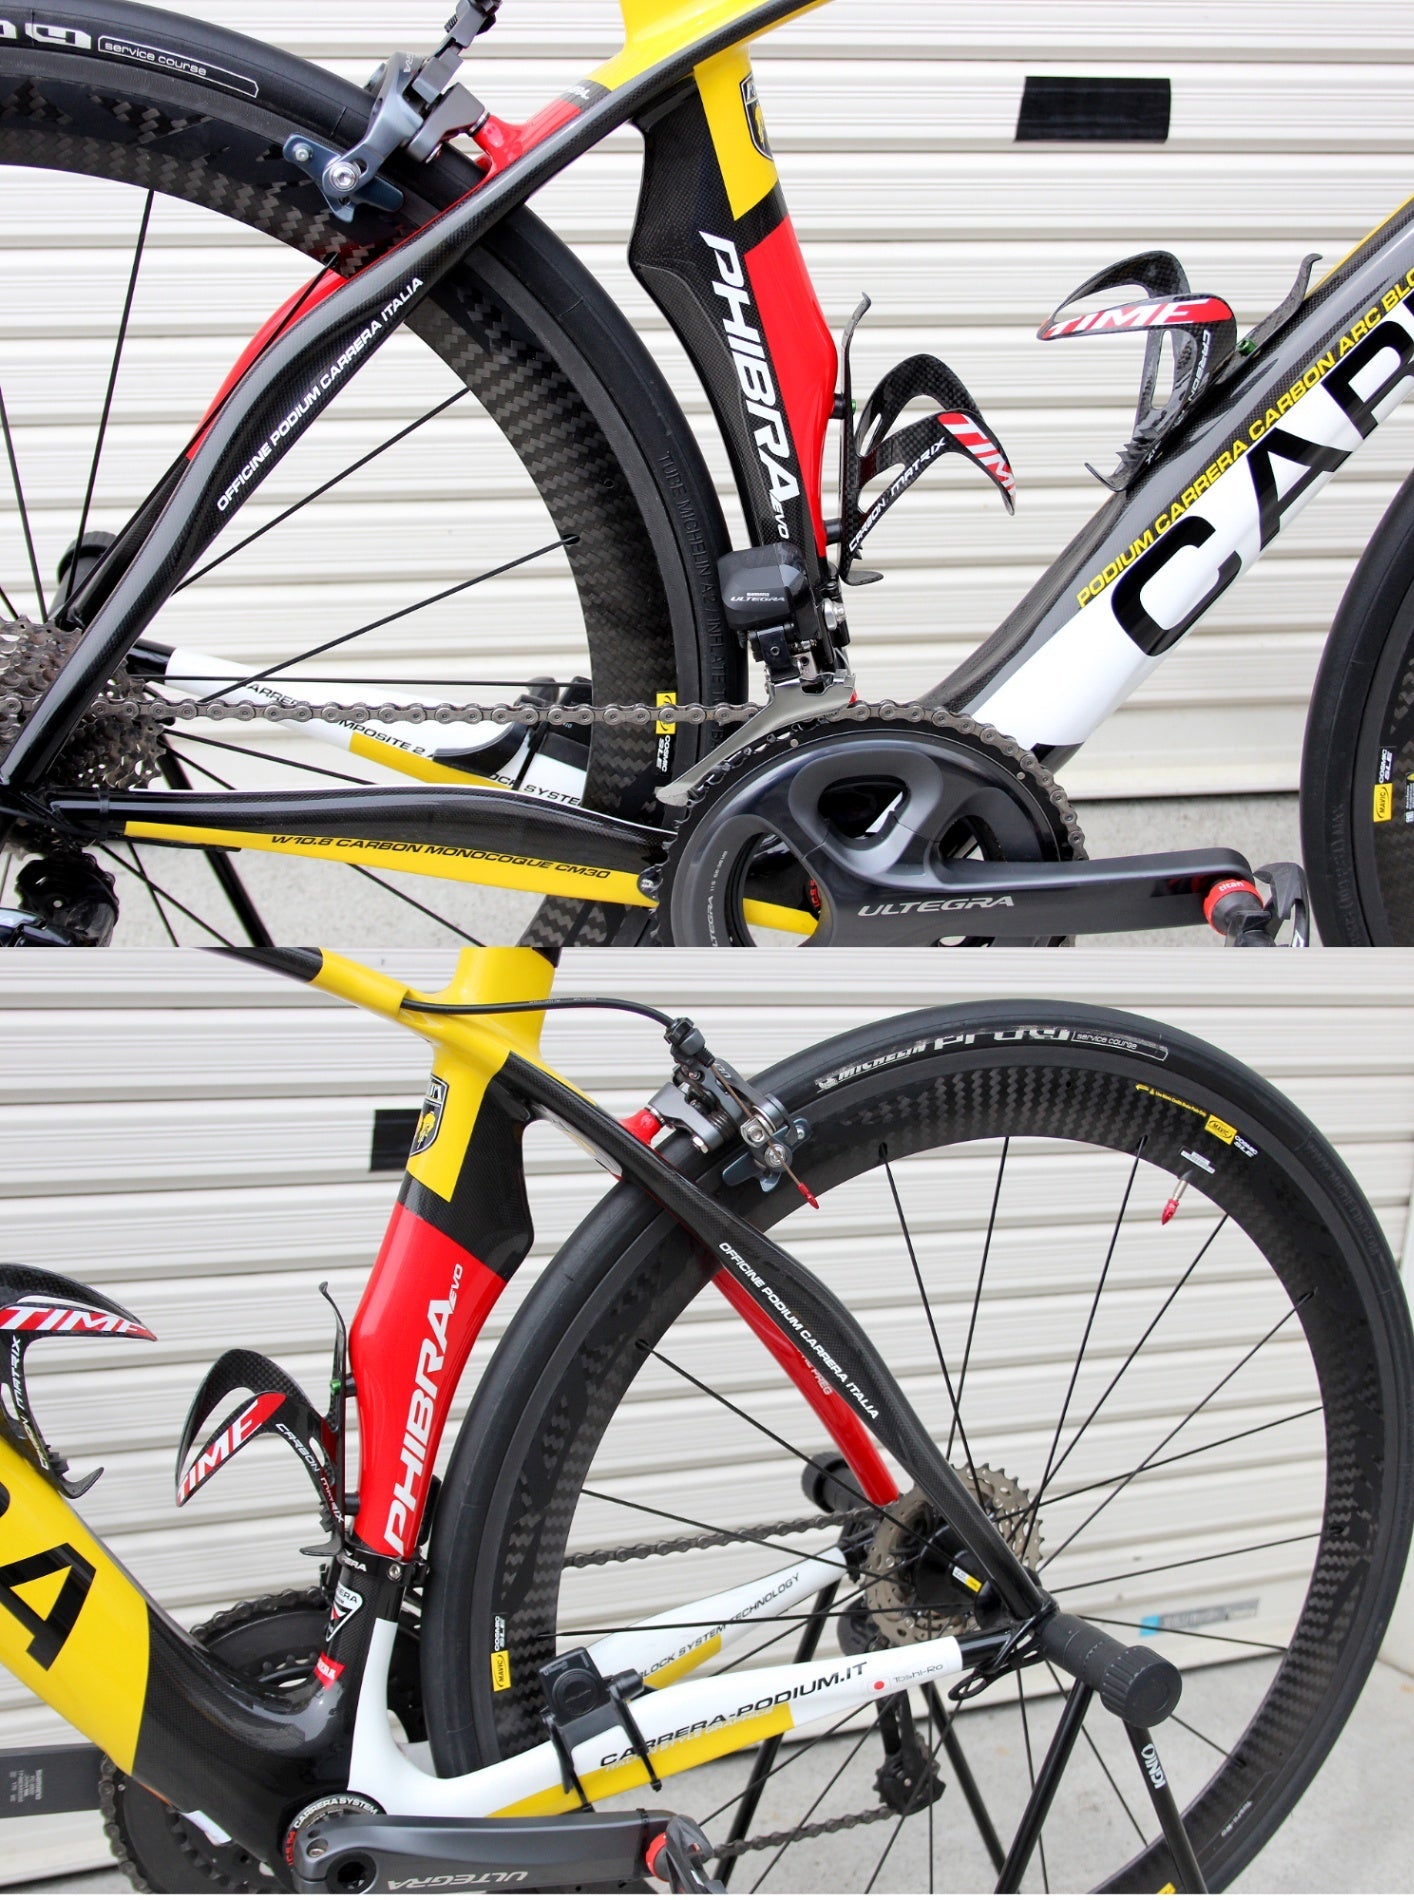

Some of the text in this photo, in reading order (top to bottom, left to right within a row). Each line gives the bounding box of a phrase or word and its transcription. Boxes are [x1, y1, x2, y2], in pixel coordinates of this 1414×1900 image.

[104, 41, 155, 62] service
[158, 54, 207, 77] course
[1048, 297, 1212, 337] TIME
[217, 277, 424, 511] OFFICINE PODIUM CARRERA ITALIA
[698, 230, 800, 539] PHIBRA EVO
[1187, 329, 1212, 402] CARBON
[942, 413, 1017, 500] TIM
[1076, 528, 1155, 609] PODIUM
[1153, 438, 1248, 535] CARRERA
[1248, 351, 1337, 441] CARBON
[1337, 305, 1382, 352] ARC
[1111, 290, 1414, 657] CAR
[849, 436, 947, 552] CARBON MATRIX
[247, 683, 306, 707] ARRE
[336, 718, 419, 751] MPOSITE
[523, 783, 583, 807] SYSTE
[661, 735, 671, 773] COSMIC
[1378, 749, 1388, 784] COSMIC
[335, 838, 424, 854] CARBON
[423, 844, 553, 870] MONOCOQUE
[553, 862, 612, 880] CM30
[1218, 880, 1246, 892] titan
[707, 895, 719, 947] LTEGRA
[857, 895, 1015, 918] ULTEGRA
[1076, 1031, 1108, 1045] service
[1107, 1036, 1139, 1051] course
[718, 1242, 880, 1420] OFFICINE PODIUM CARRERA ITALIA
[11, 1335, 25, 1410] MATRIX
[384, 1263, 464, 1556] PHIBRA EVO
[178, 1399, 263, 1502] TIME
[275, 1423, 321, 1472] CARBON
[678, 1623, 728, 1657] SYSTEM
[730, 1572, 800, 1622] TECHNOLOGY
[892, 1663, 944, 1682] Toshi-Ro
[293, 1797, 339, 1829] CARRERA
[338, 1796, 379, 1815] SYSTEM
[387, 1870, 529, 1891] ULTEGRA
